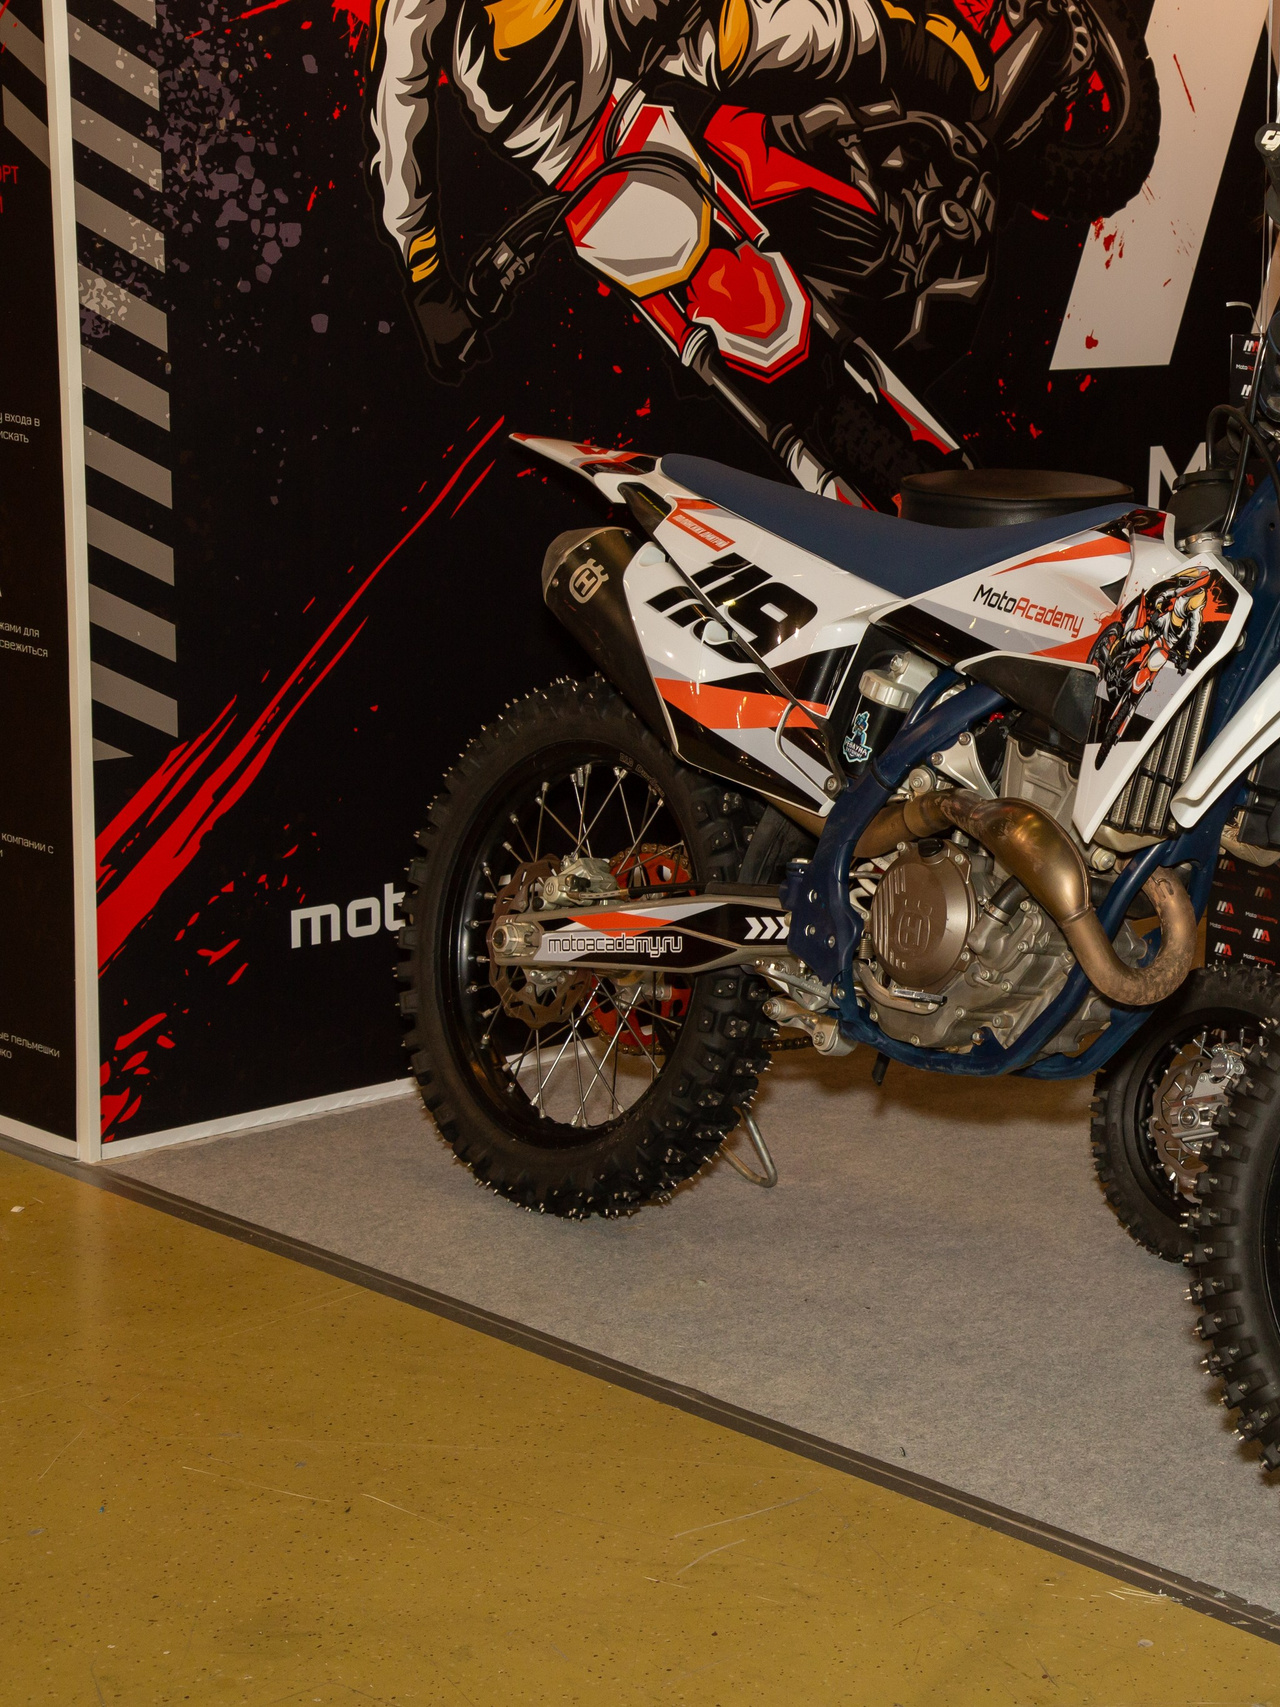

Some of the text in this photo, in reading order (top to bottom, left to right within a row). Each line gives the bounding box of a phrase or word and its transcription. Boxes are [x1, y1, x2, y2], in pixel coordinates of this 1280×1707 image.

[4, 412, 32, 426] входа
[33, 417, 41, 427] в
[972, 583, 1085, 639] MotoAcademy
[23, 627, 40, 638] для
[1, 832, 54, 855] компании с
[548, 932, 683, 958] motoacademy.ru
[10, 1034, 60, 1058] пельмешки
